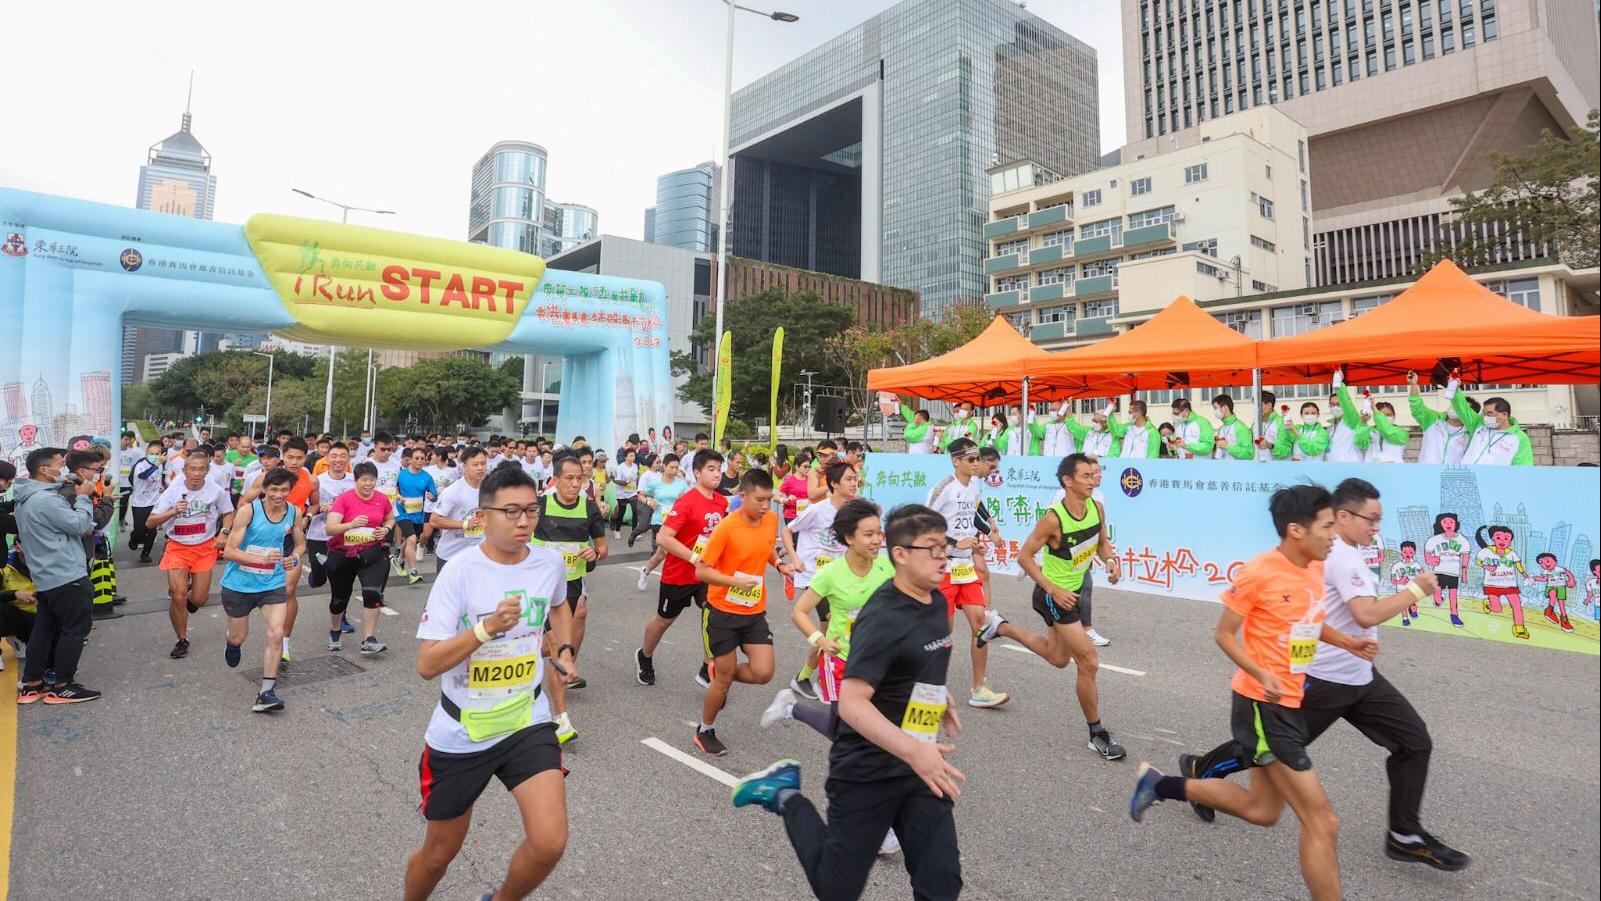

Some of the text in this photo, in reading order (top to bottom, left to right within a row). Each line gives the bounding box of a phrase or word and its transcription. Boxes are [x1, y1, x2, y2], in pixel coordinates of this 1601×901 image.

[312, 273, 377, 305] Run
[380, 265, 524, 315] START
[876, 470, 928, 489] 奔向共融
[1006, 467, 1041, 483] 東華三院
[473, 660, 535, 682] M2007
